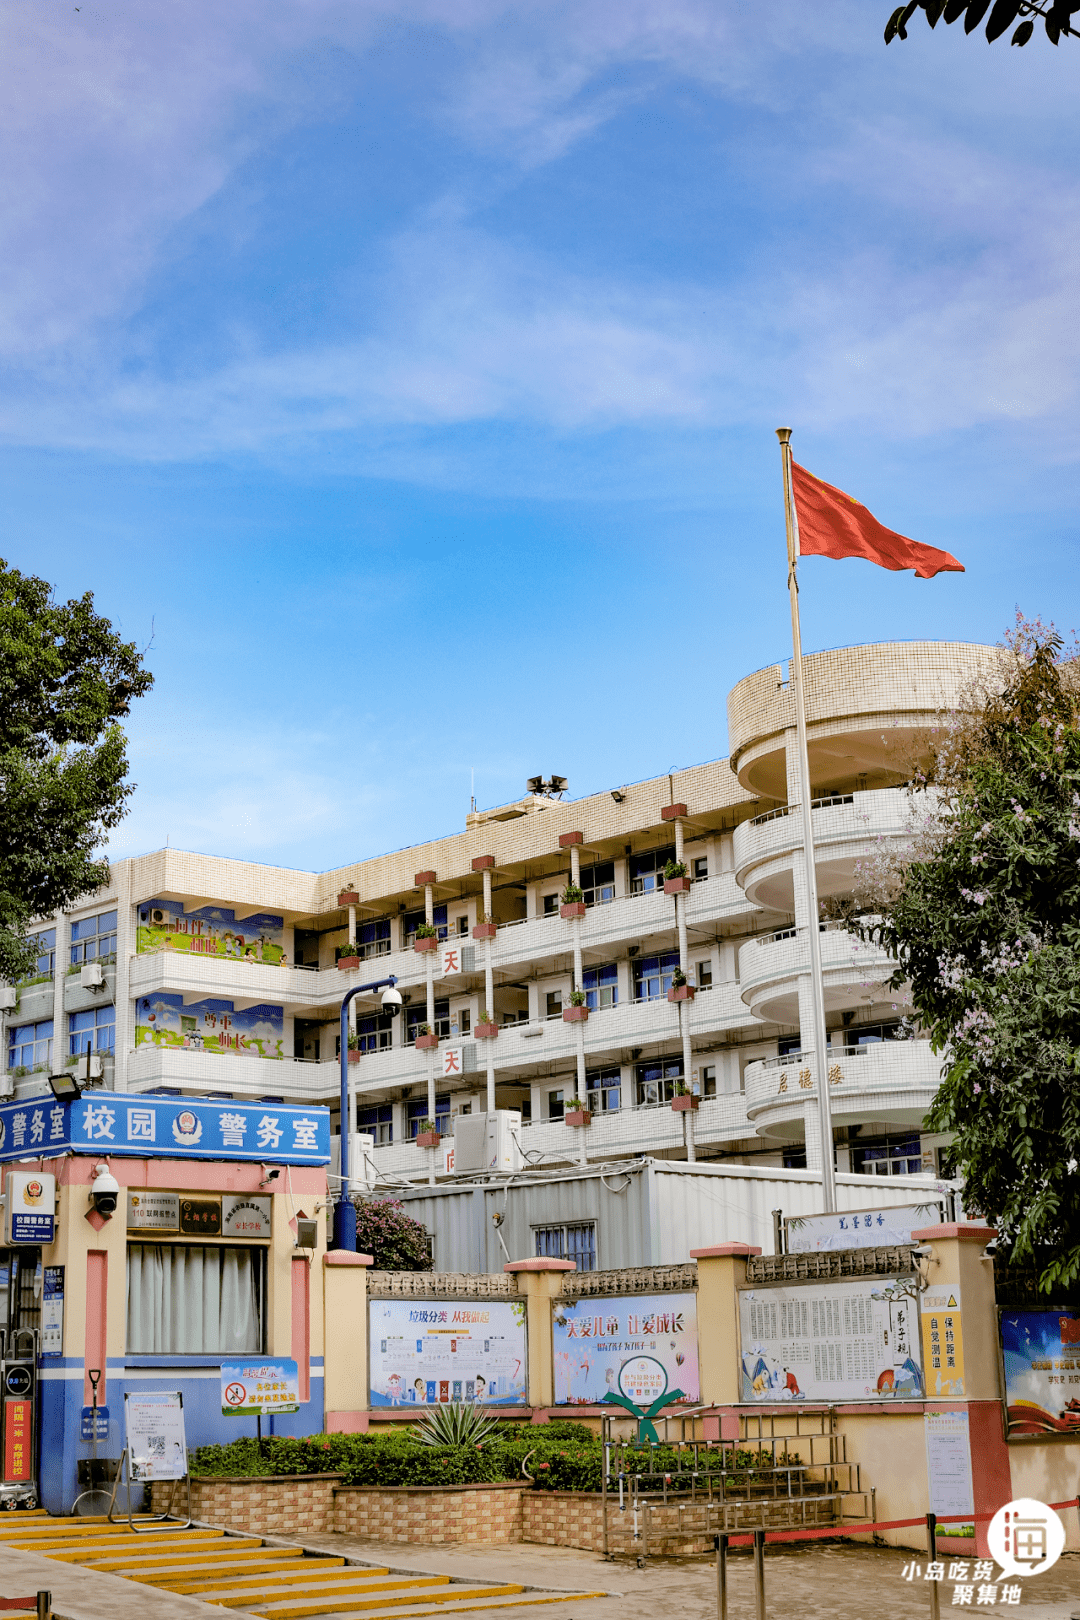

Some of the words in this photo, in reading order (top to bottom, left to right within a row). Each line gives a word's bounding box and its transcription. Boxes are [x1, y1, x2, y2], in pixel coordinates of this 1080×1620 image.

[444, 950, 459, 972] 天
[445, 1051, 460, 1073] 天
[12, 1105, 65, 1147] 警务室
[82, 1103, 156, 1142] 校园
[218, 1112, 319, 1150] 警务室
[132, 1209, 144, 1217] 110
[408, 1310, 448, 1323] 垃圾分类
[451, 1310, 490, 1323] 从我做起
[567, 1315, 620, 1338] 关爱儿童
[628, 1312, 685, 1335] 让爱成长
[897, 1310, 909, 1355] 弟子规
[930, 1317, 941, 1369] 自觉测温
[944, 1317, 956, 1368] 保持距离
